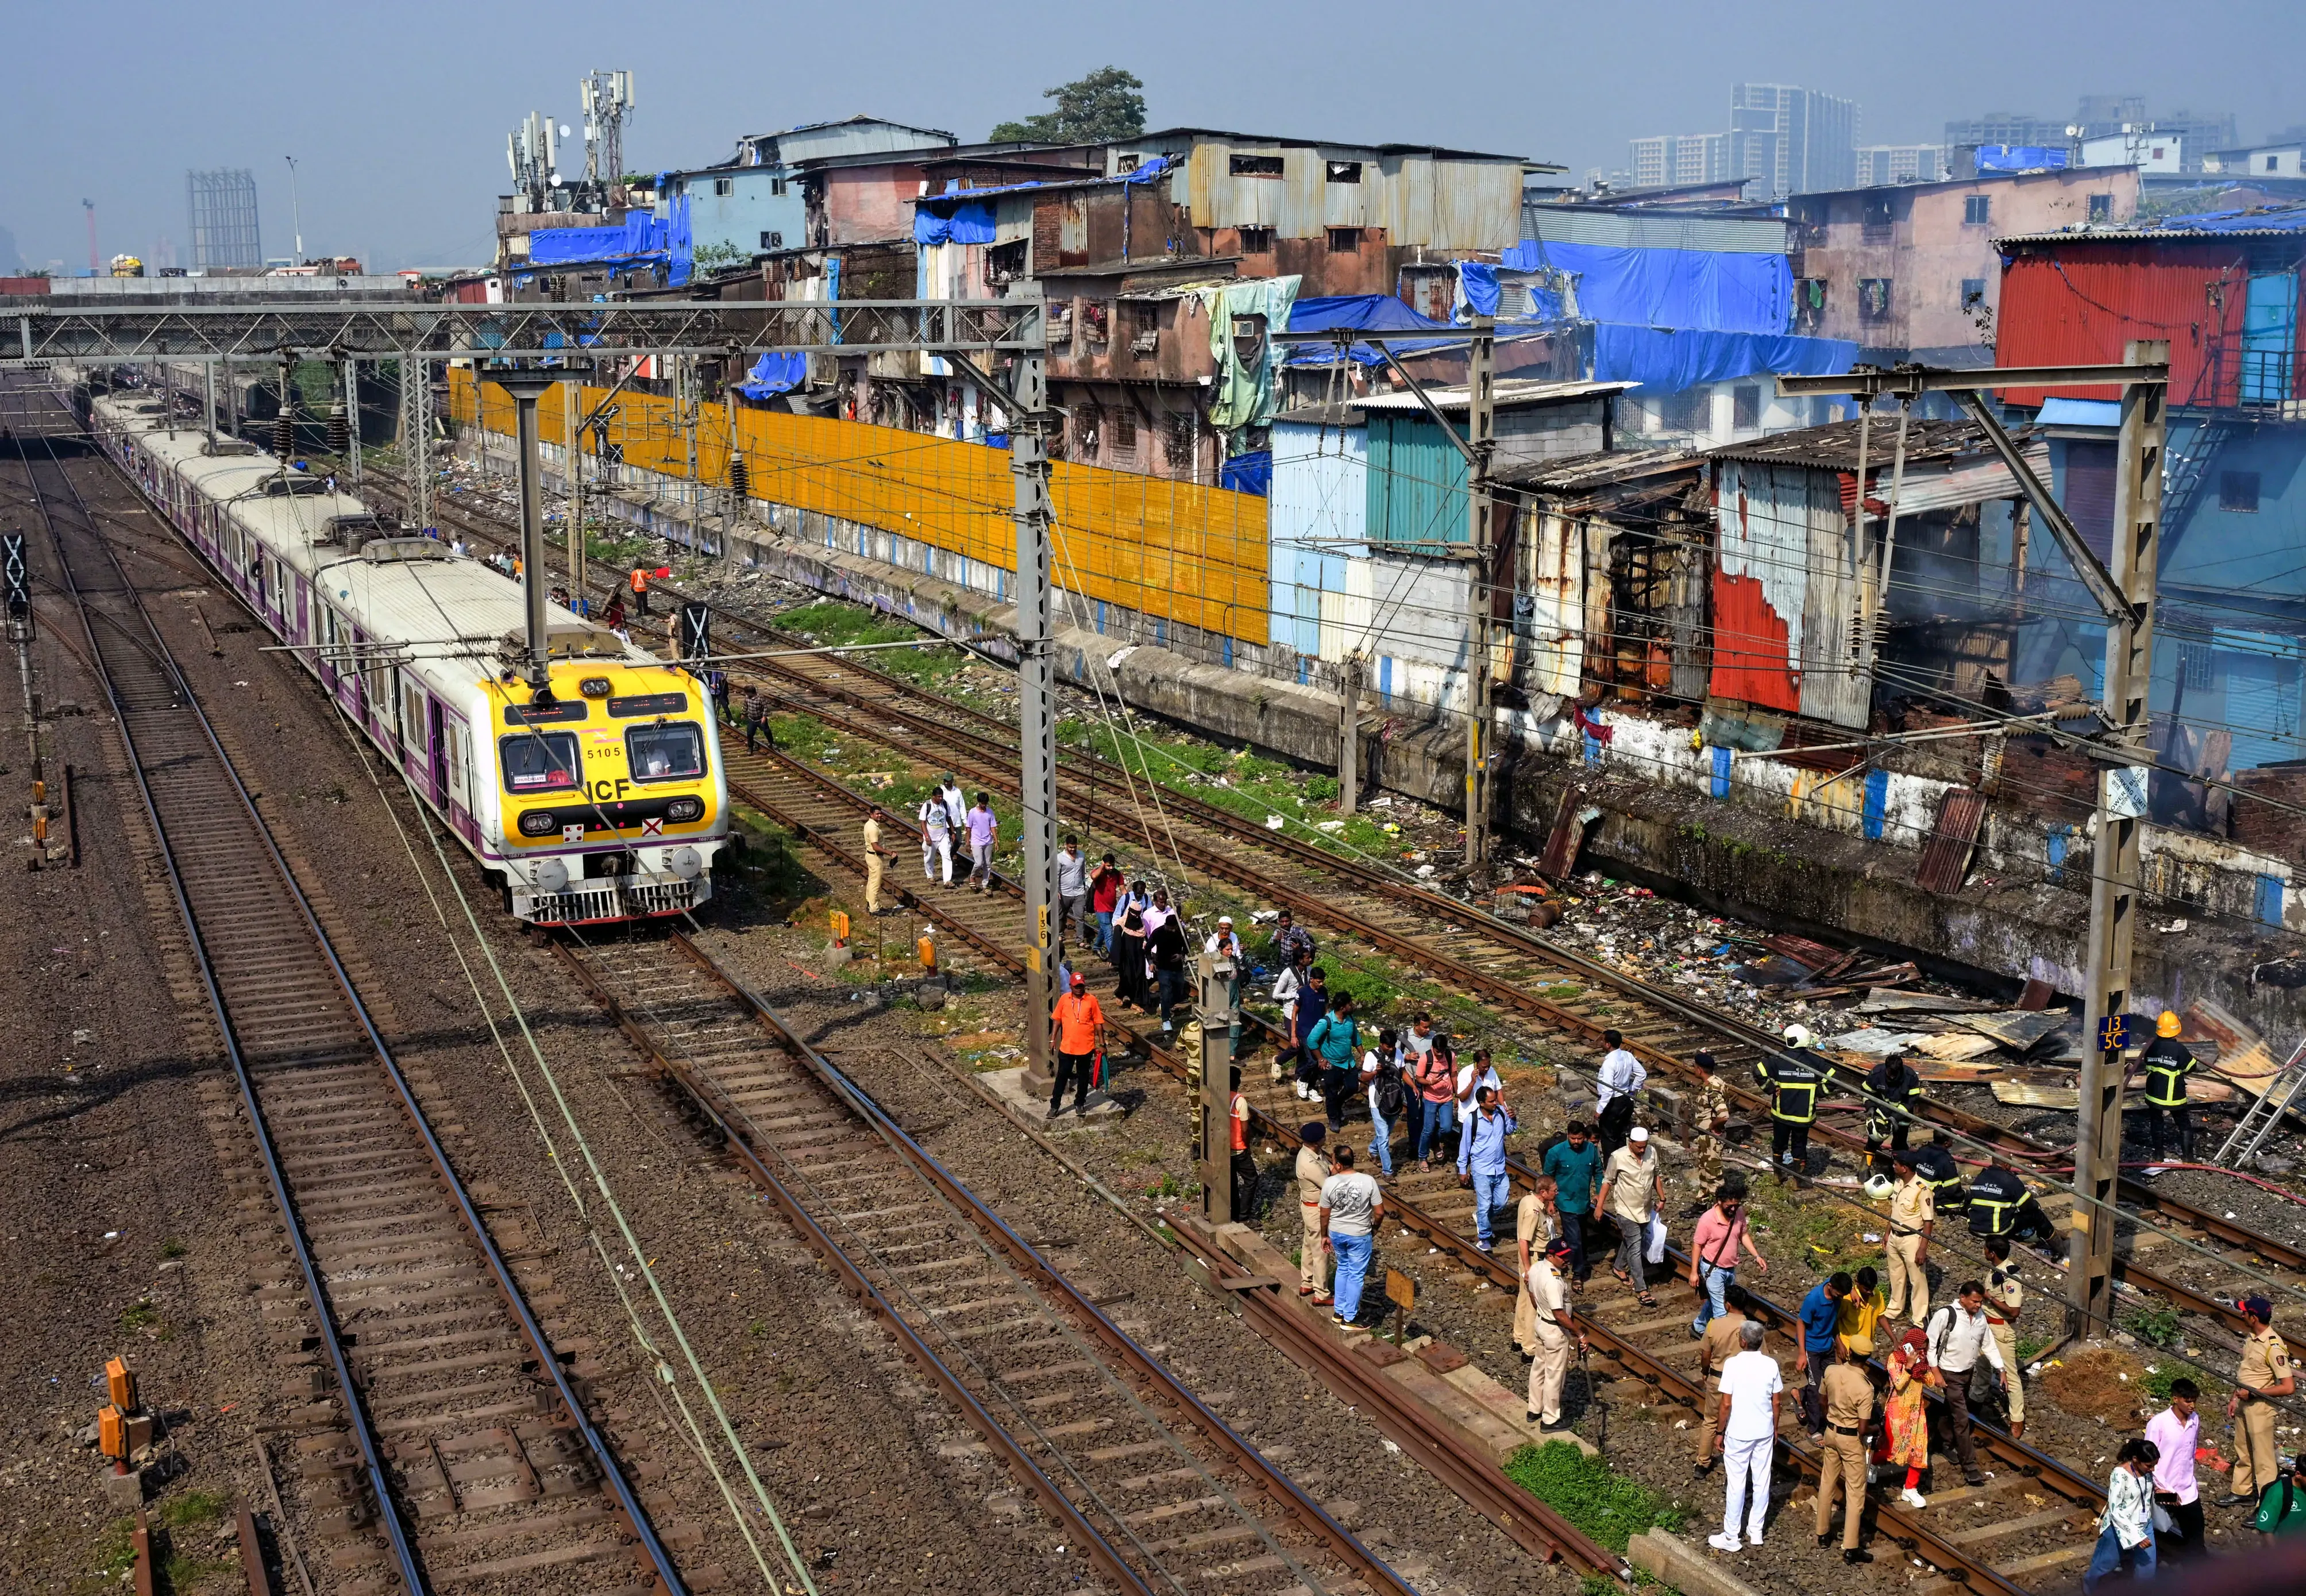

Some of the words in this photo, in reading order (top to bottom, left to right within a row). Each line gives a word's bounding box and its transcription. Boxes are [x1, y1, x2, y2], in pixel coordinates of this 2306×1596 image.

[587, 747, 620, 759] 5105
[2129, 767, 2144, 786] BLOCK
[586, 778, 630, 802] ICF
[2112, 770, 2134, 796] WORKING
[2133, 795, 2146, 809] LIMIT
[2108, 1016, 2121, 1032] 13
[2104, 1032, 2123, 1049] 5C
